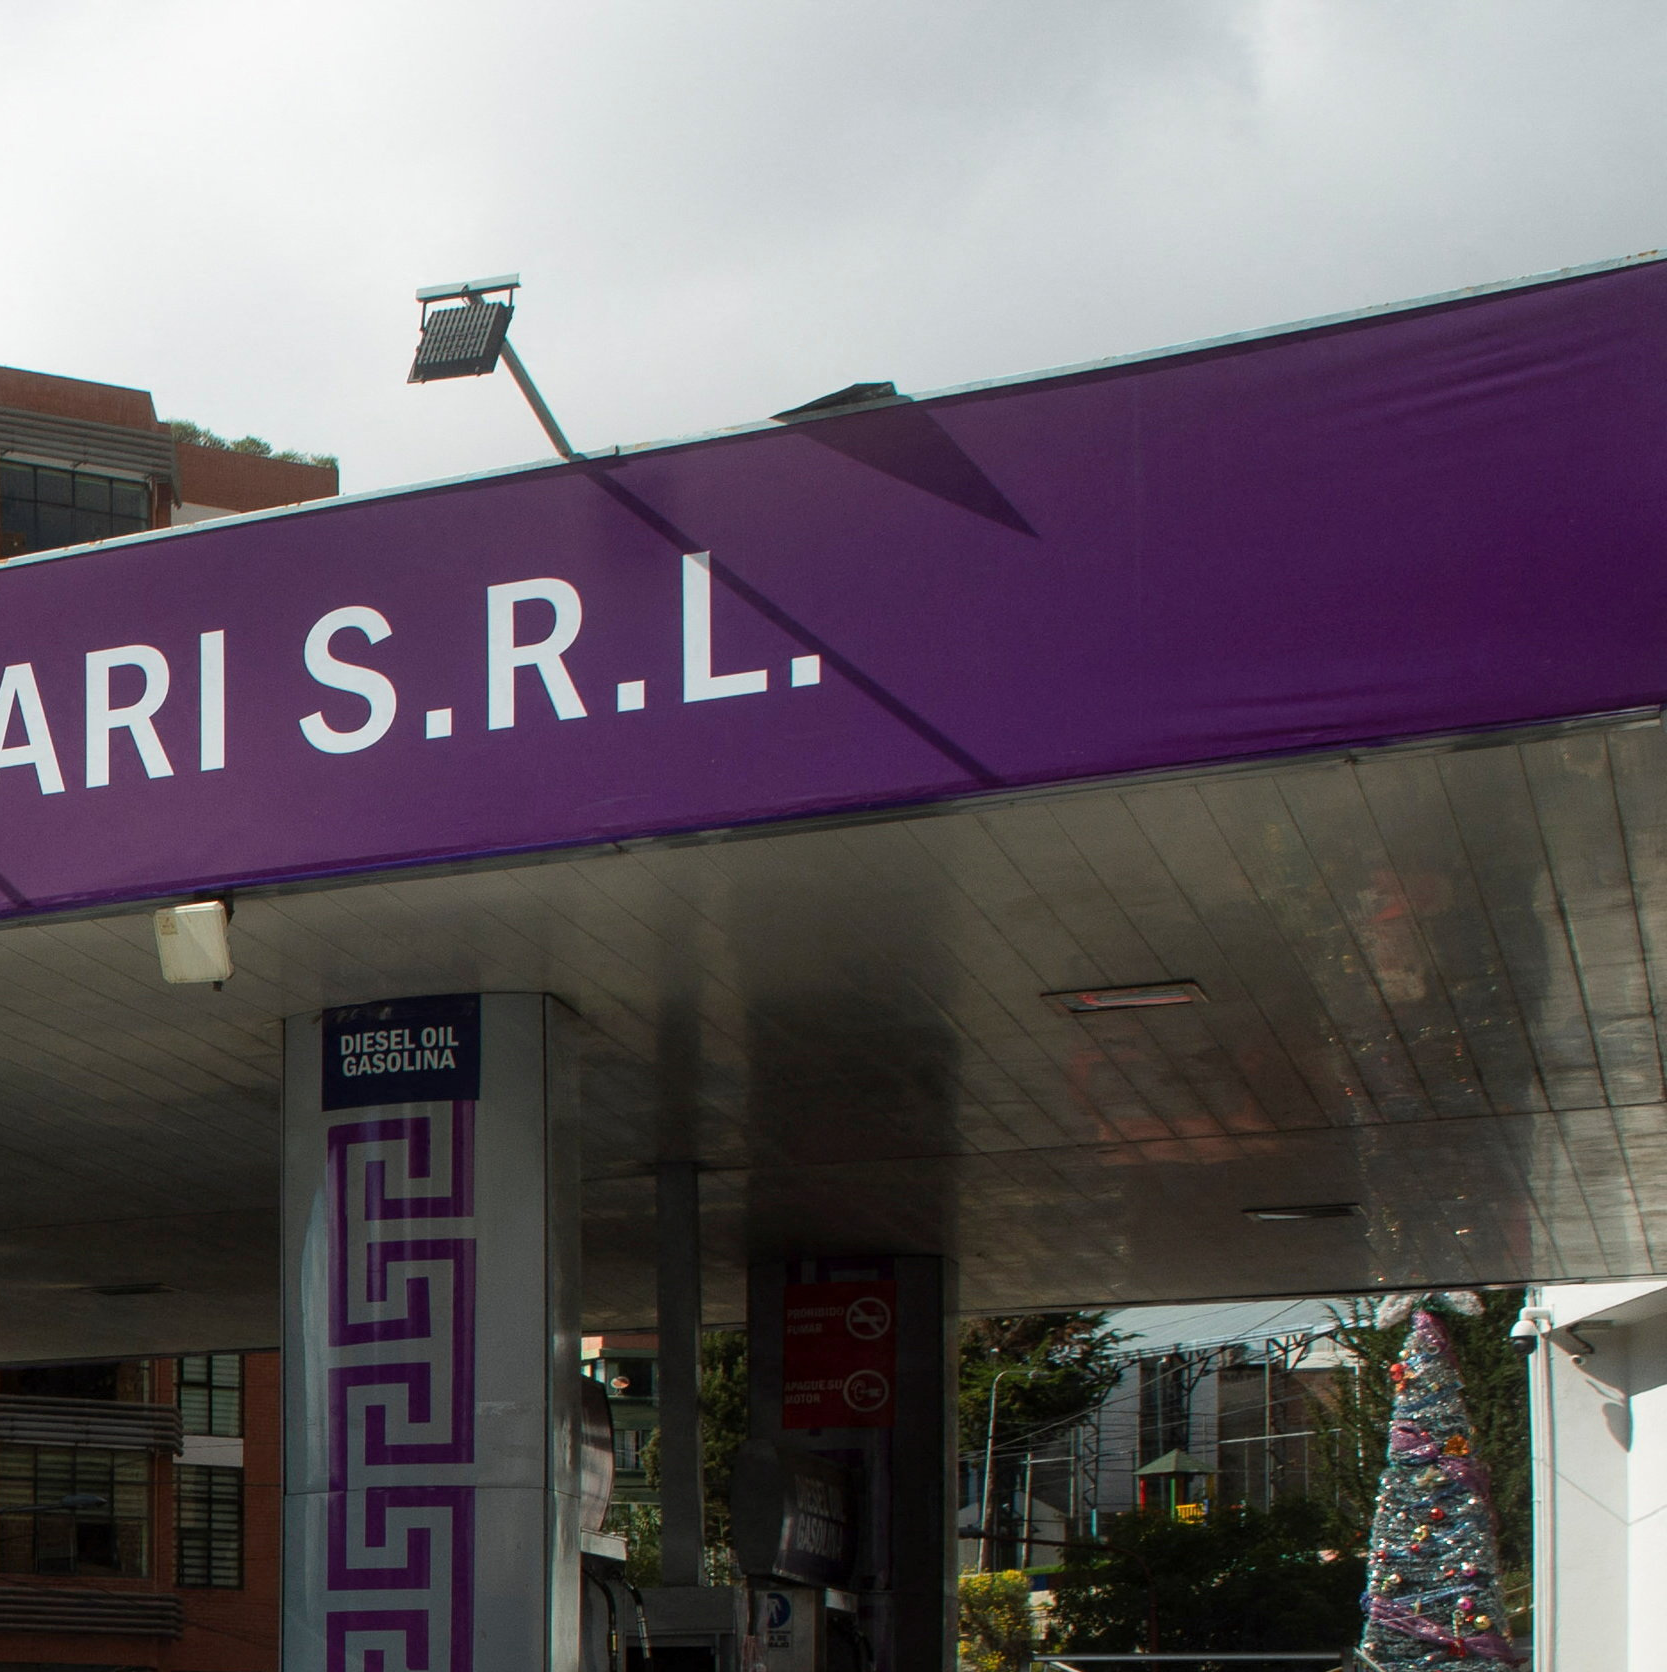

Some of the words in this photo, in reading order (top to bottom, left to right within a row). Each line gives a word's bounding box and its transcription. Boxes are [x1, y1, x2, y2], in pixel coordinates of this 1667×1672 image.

[299, 551, 821, 755] S.R.L.
[340, 1028, 416, 1056] DIESEL
[420, 1026, 459, 1048] OIL
[342, 1048, 456, 1077] GASOLINA
[786, 1306, 844, 1319] PROHIBIDO
[786, 1324, 823, 1335] FUMAR
[785, 1380, 827, 1392] APAGUE
[828, 1379, 843, 1390] SU
[785, 1394, 821, 1405] MOTOR
